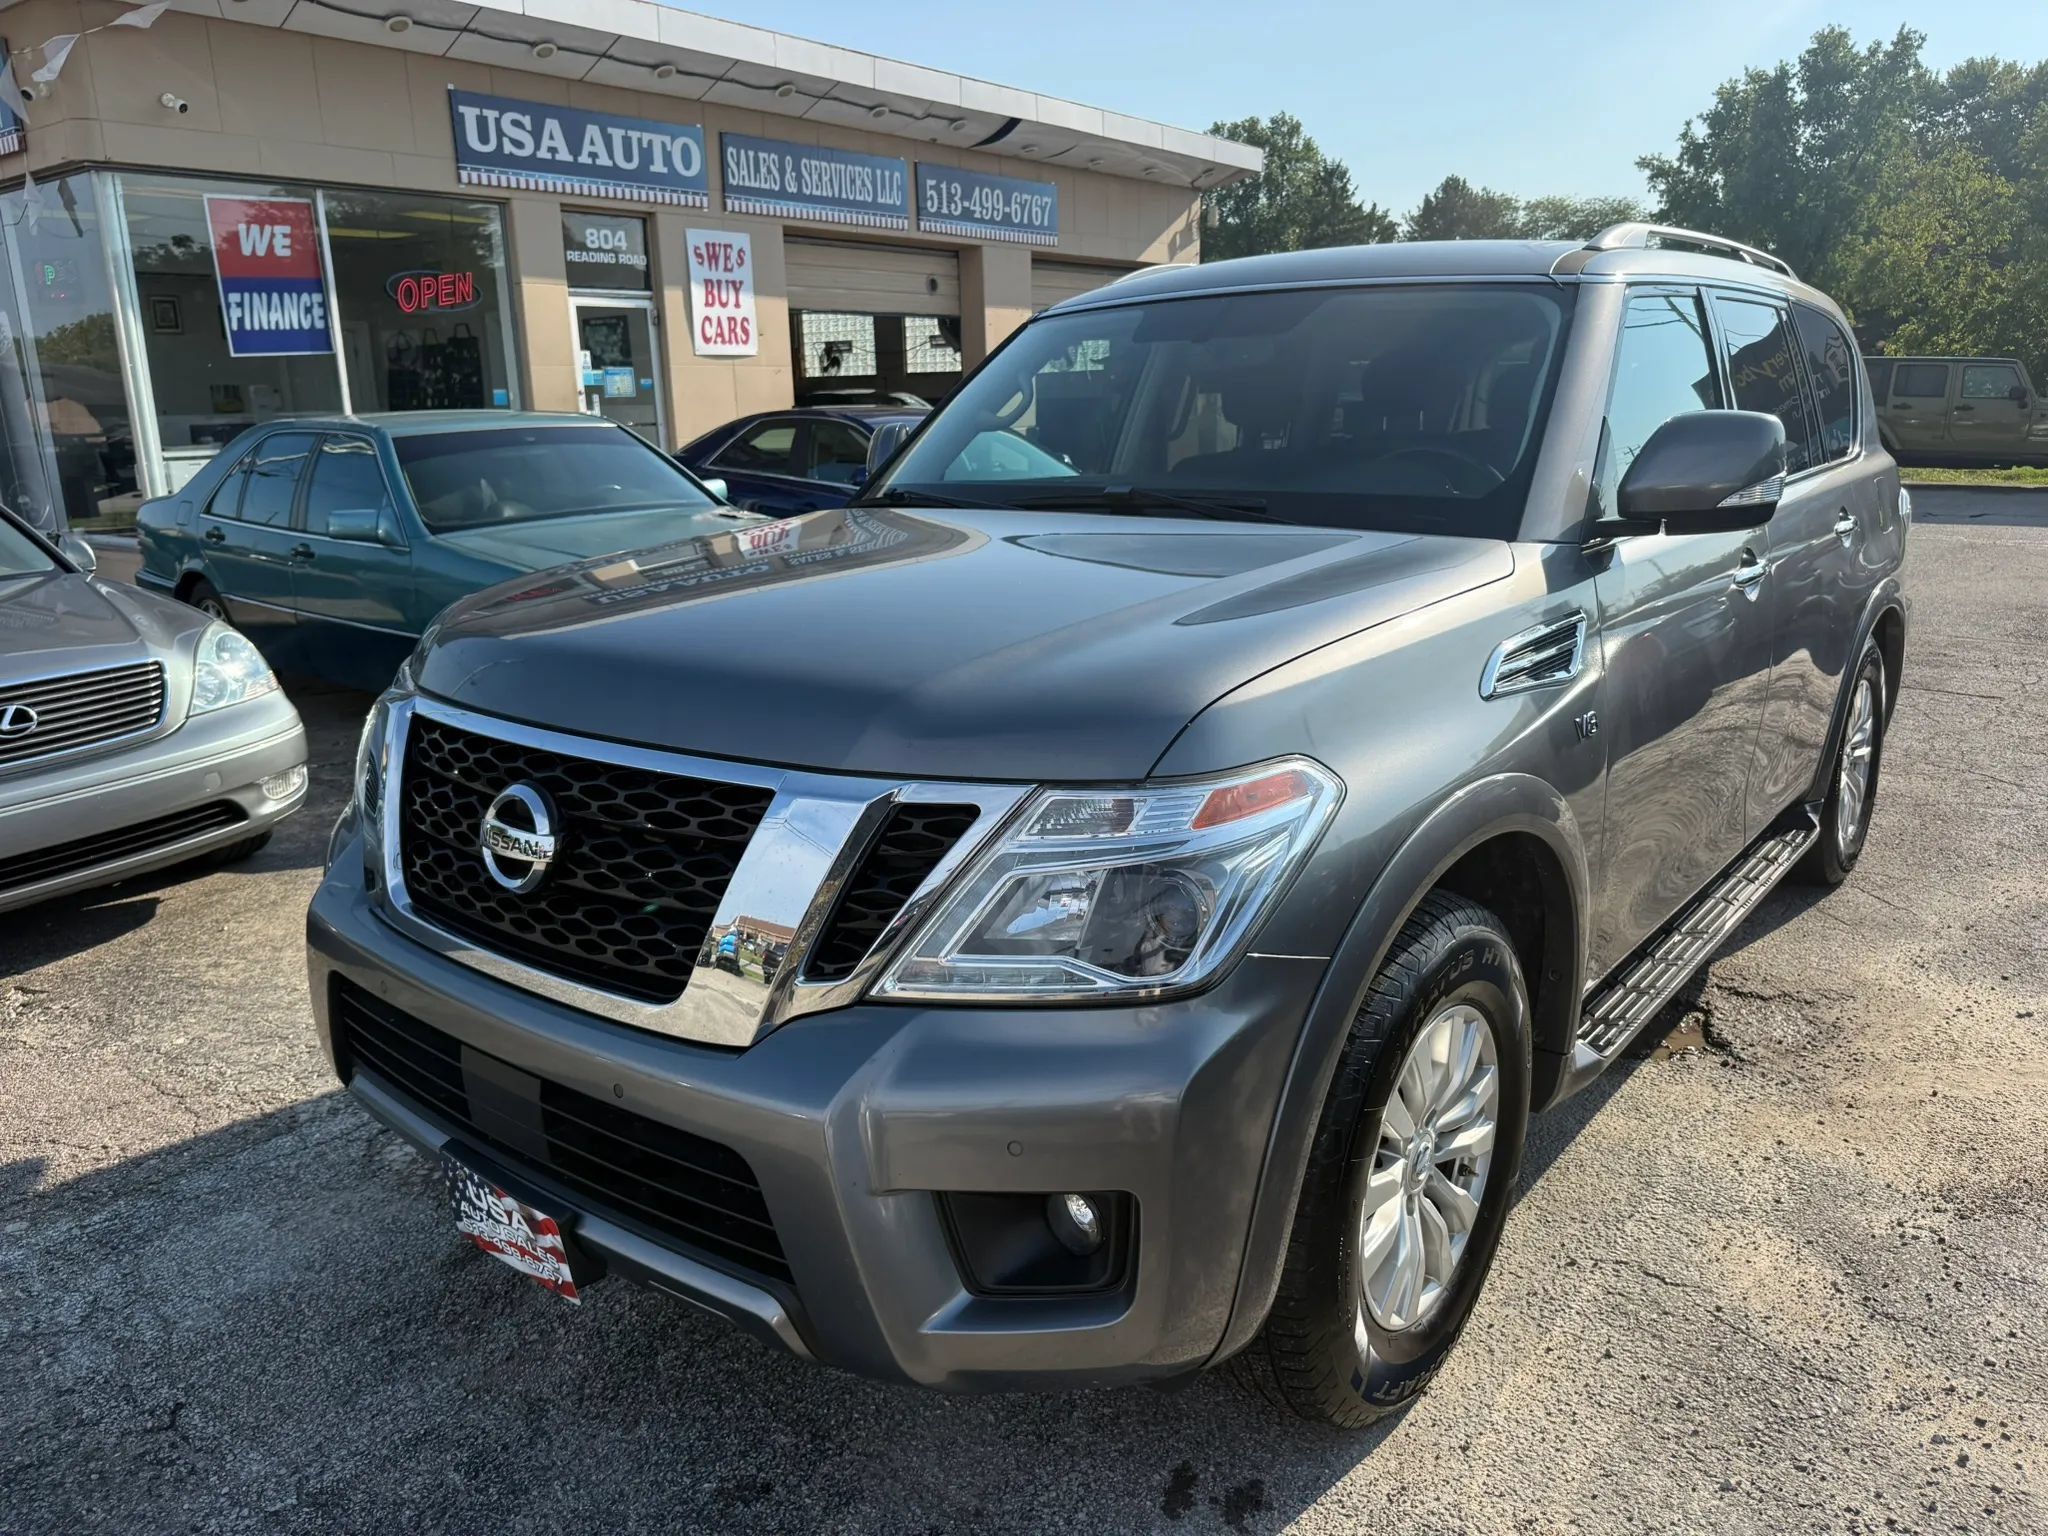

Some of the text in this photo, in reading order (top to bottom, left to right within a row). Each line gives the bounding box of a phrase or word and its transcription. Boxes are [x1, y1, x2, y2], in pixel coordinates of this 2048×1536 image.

[458, 105, 702, 177] USA AUTO
[727, 146, 902, 206] SALES & SERVICES LLC
[926, 179, 1052, 227] 513-499-6767
[237, 223, 292, 257] WE
[566, 251, 647, 266] READING ROAD
[585, 228, 628, 250] 804
[227, 292, 326, 331] FINANCE
[397, 272, 473, 312] OPEN
[703, 278, 744, 309] BUY
[701, 316, 750, 345] CARS
[483, 826, 540, 857] NISSAN
[466, 1179, 536, 1240] USA
[460, 1201, 560, 1270] AUTO SALES
